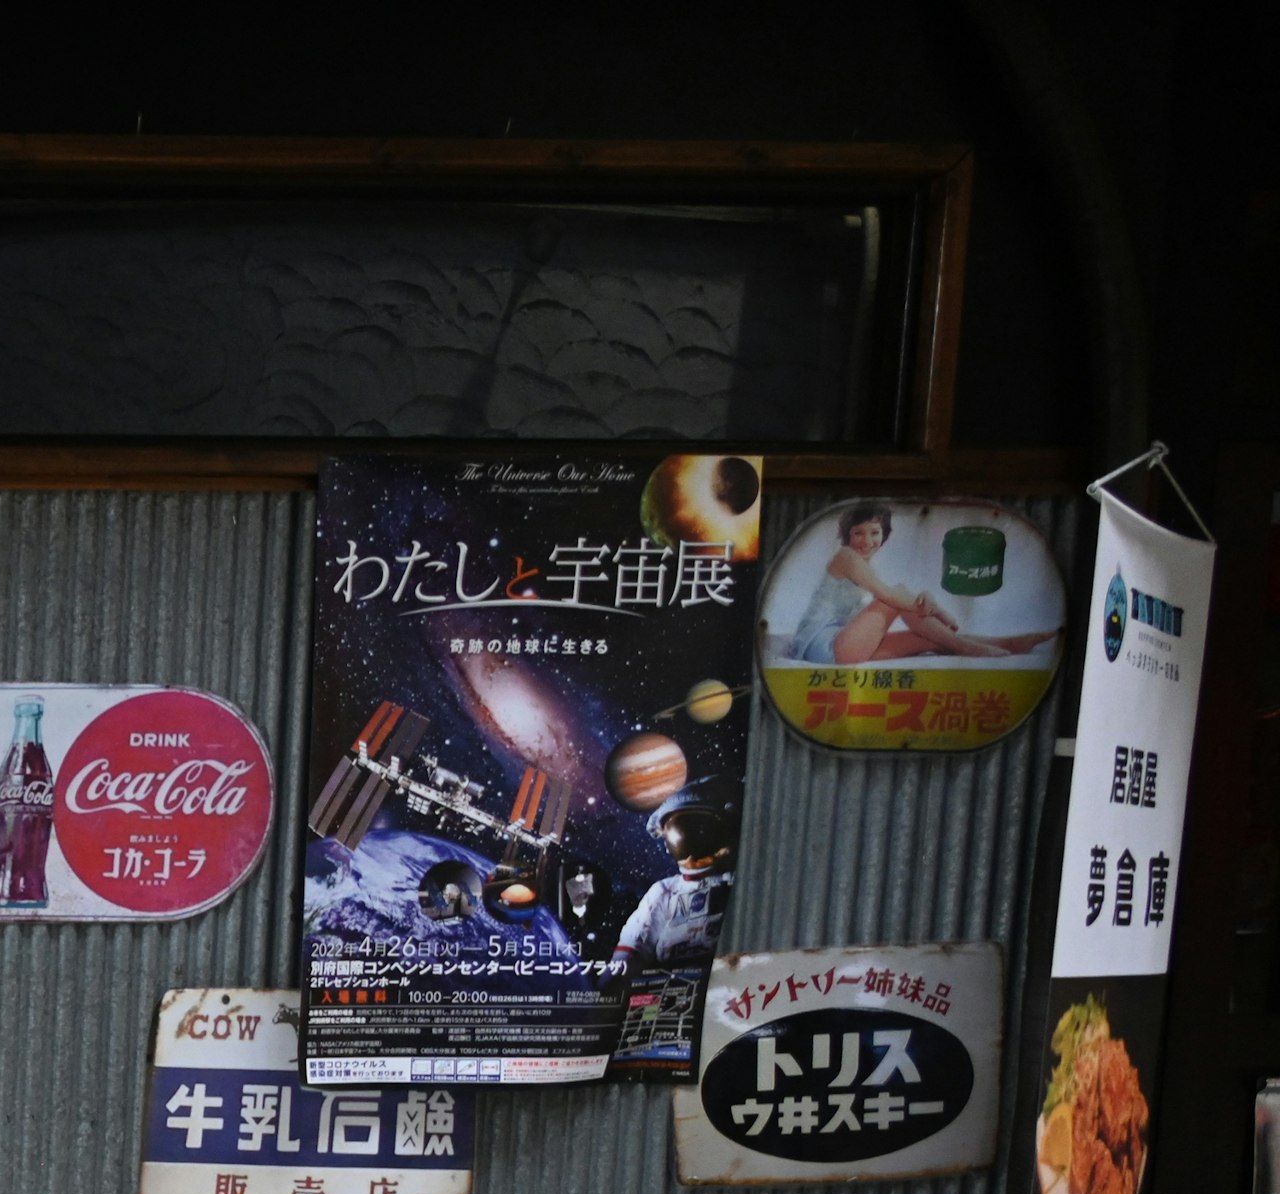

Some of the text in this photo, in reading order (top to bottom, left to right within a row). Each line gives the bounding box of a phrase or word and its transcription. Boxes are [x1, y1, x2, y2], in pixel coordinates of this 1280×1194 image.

[456, 463, 483, 480] The
[488, 464, 551, 481] Universe
[557, 463, 588, 481] Our
[333, 537, 735, 608] わたしと宇宙展
[450, 638, 608, 655] 奇跡の地球に生きる
[807, 670, 917, 689] かとり線香
[803, 690, 1011, 734] アース渦巻
[130, 733, 190, 747] DRINK
[65, 758, 255, 815] Coca-Cola
[1109, 745, 1159, 809] 居酒屋
[102, 847, 207, 879] コカ・コーラ
[1086, 843, 1171, 929] 夢倉庫
[724, 966, 952, 1020] サントリー姉妹品
[189, 1014, 261, 1040] COW
[756, 1029, 921, 1092] トリス
